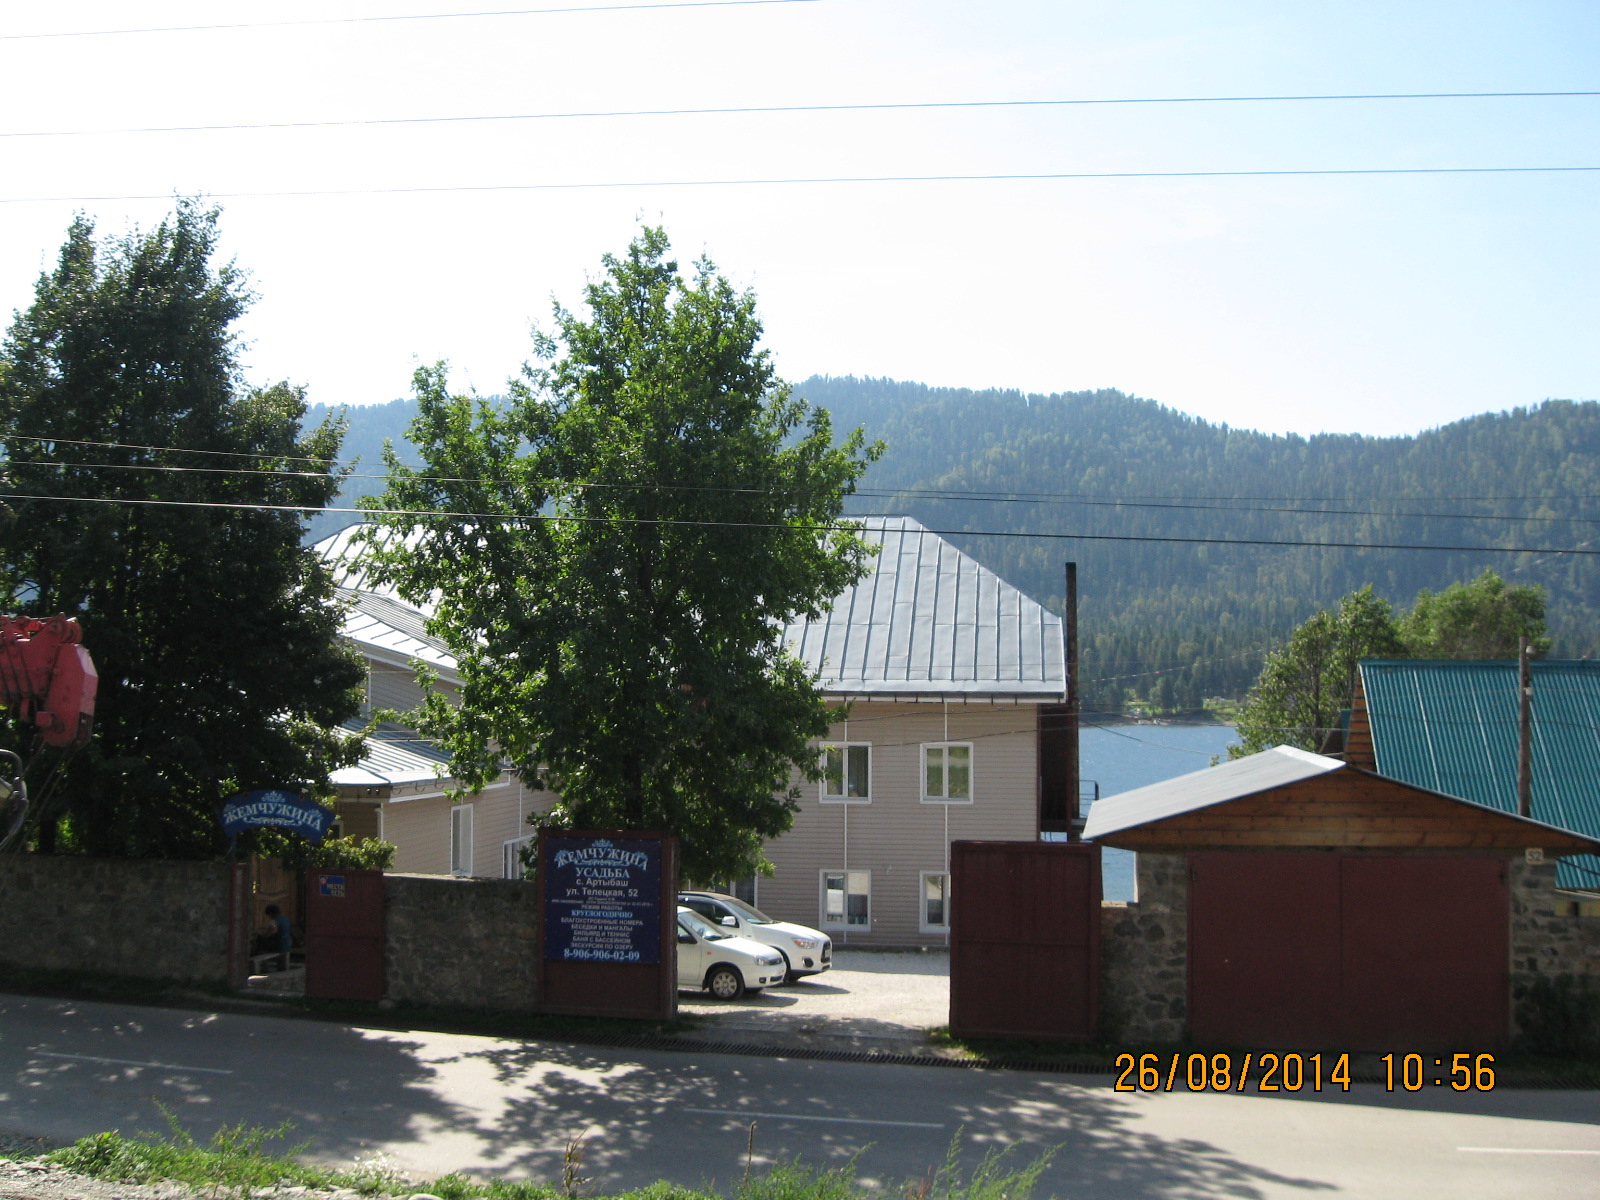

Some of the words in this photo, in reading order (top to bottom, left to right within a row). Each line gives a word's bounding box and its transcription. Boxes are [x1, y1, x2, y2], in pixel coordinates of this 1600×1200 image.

[224, 802, 321, 831] ЖЕМЧУЖИНА
[554, 847, 648, 871] ЖЕМЧУЖИНА
[575, 867, 631, 879] УСАДЬБА
[586, 877, 629, 887] Артыбаш
[566, 888, 580, 896] ул.
[582, 887, 626, 897] Телецкая,
[628, 888, 639, 897] 52
[571, 910, 633, 918] КРУГЛОГОДИЧНО
[563, 948, 640, 960] 8-906-906-02-09
